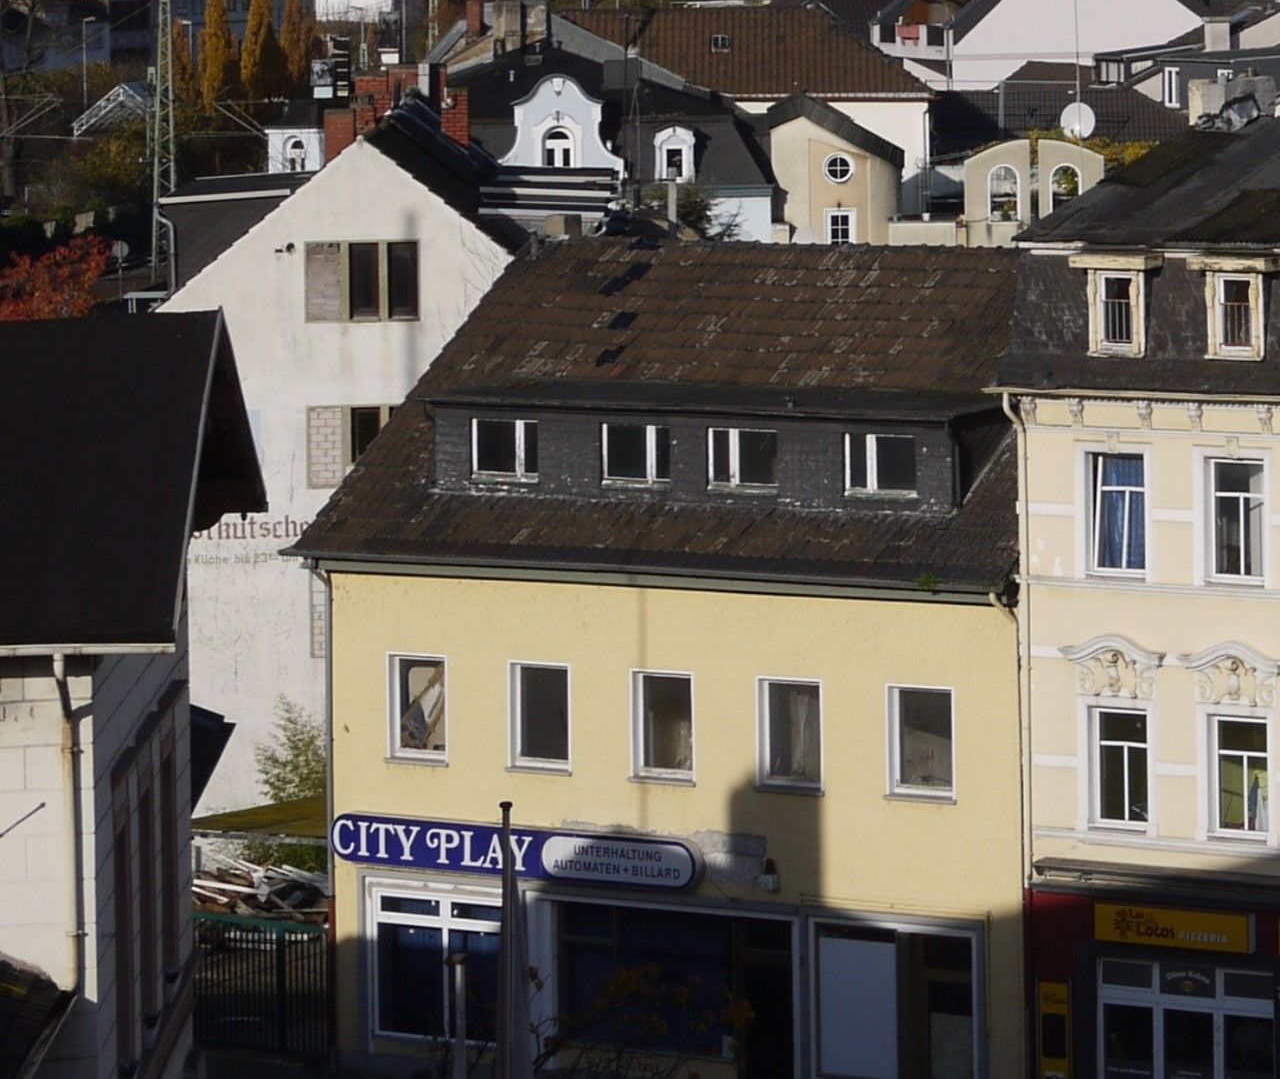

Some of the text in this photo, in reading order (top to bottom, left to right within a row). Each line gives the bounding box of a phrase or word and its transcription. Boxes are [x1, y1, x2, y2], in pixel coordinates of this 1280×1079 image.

[333, 820, 533, 871] CITY PLAY
[574, 845, 662, 862] UNTERHALTUNG
[553, 859, 620, 874] AUTOMATEN
[632, 867, 680, 880] BILLARD
[1178, 930, 1228, 944] PIZZERIA
